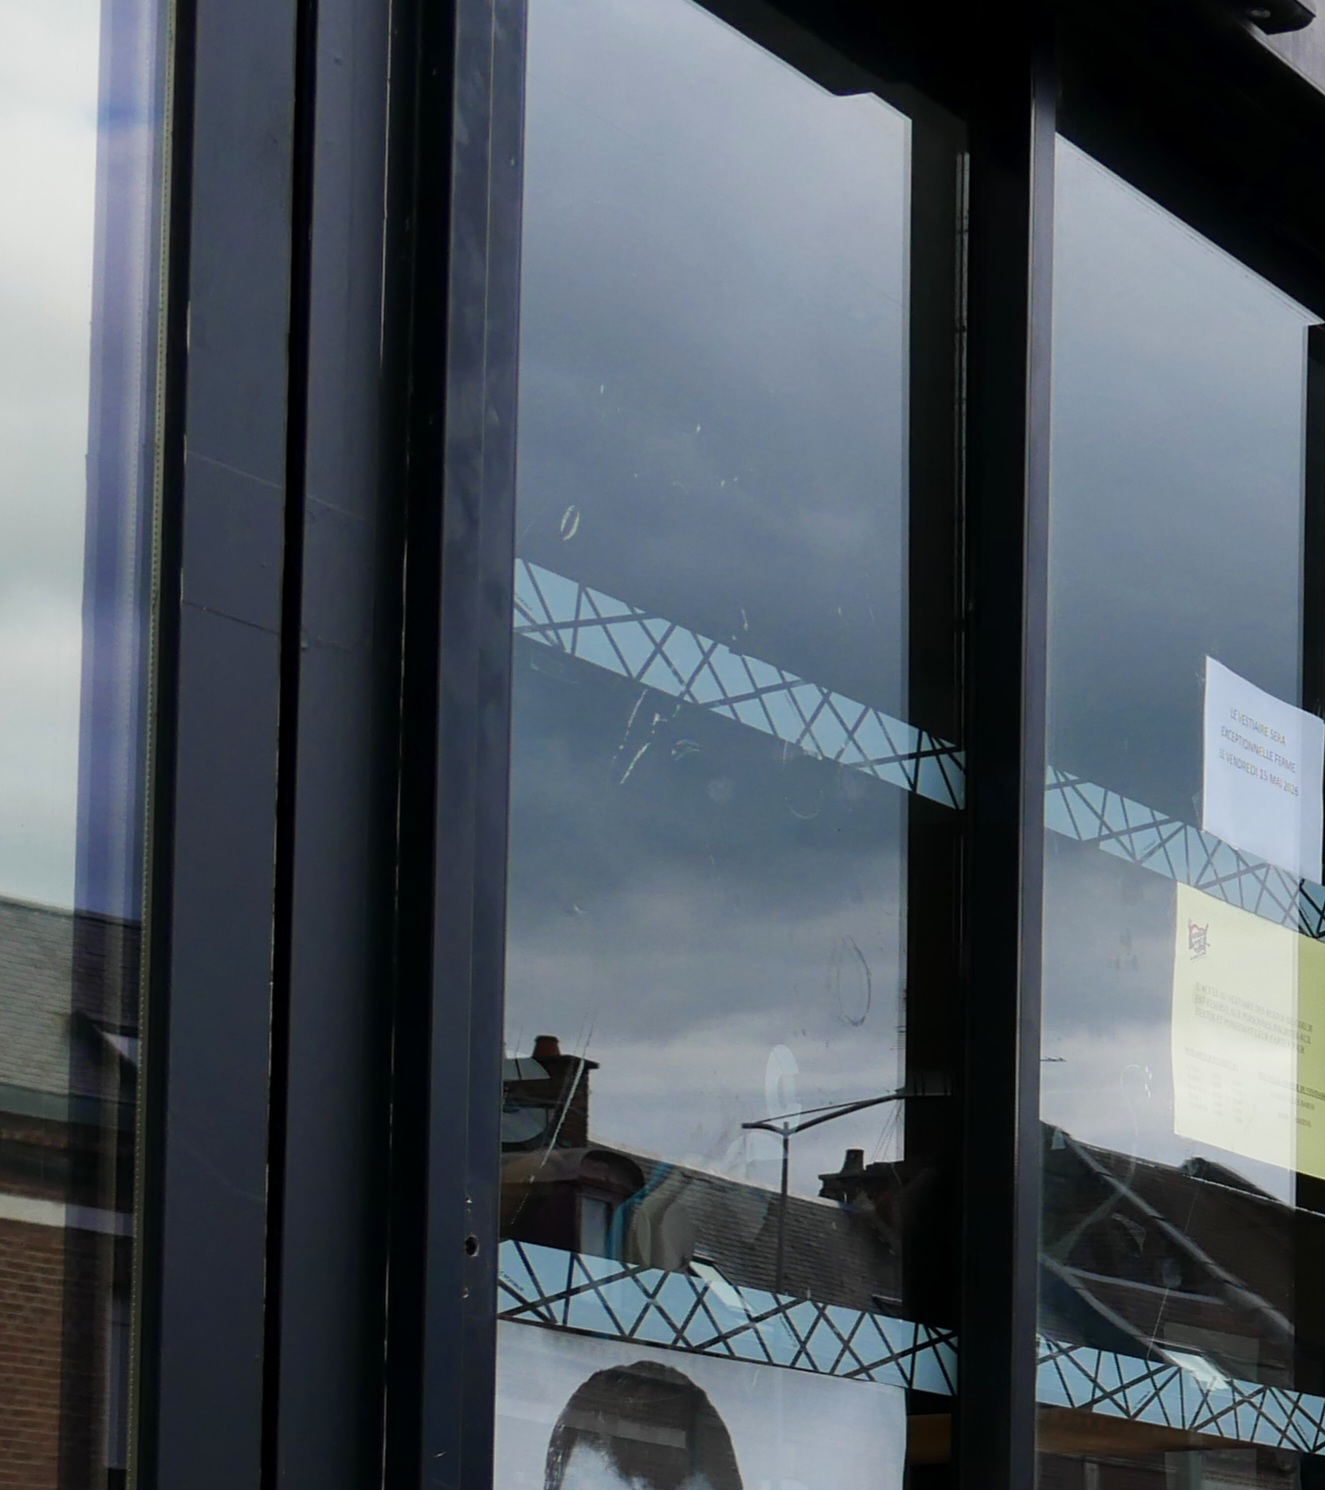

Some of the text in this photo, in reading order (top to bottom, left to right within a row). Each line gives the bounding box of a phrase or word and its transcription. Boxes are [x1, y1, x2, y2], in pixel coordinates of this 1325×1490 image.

[1238, 712, 1268, 737] VESTIAIRE
[1270, 727, 1286, 746] SERA
[1226, 752, 1258, 777] VENDREDI
